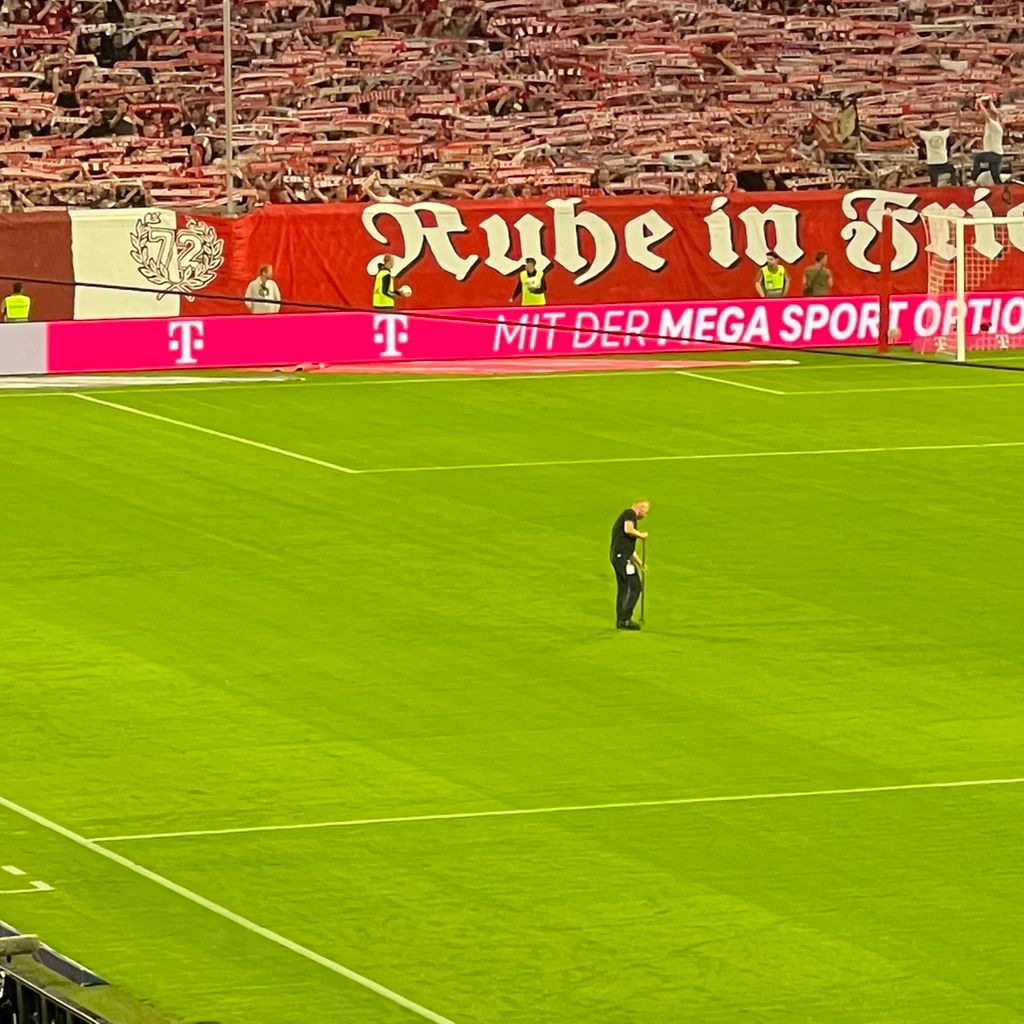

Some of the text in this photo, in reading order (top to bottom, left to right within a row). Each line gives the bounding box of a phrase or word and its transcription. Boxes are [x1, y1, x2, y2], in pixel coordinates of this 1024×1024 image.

[148, 228, 203, 270] 72
[361, 196, 674, 285] Ruhe
[704, 196, 804, 268] in
[492, 312, 566, 352] MIT
[572, 309, 649, 349] DER
[658, 306, 770, 346] MEGA
[780, 301, 907, 343] SPORT
